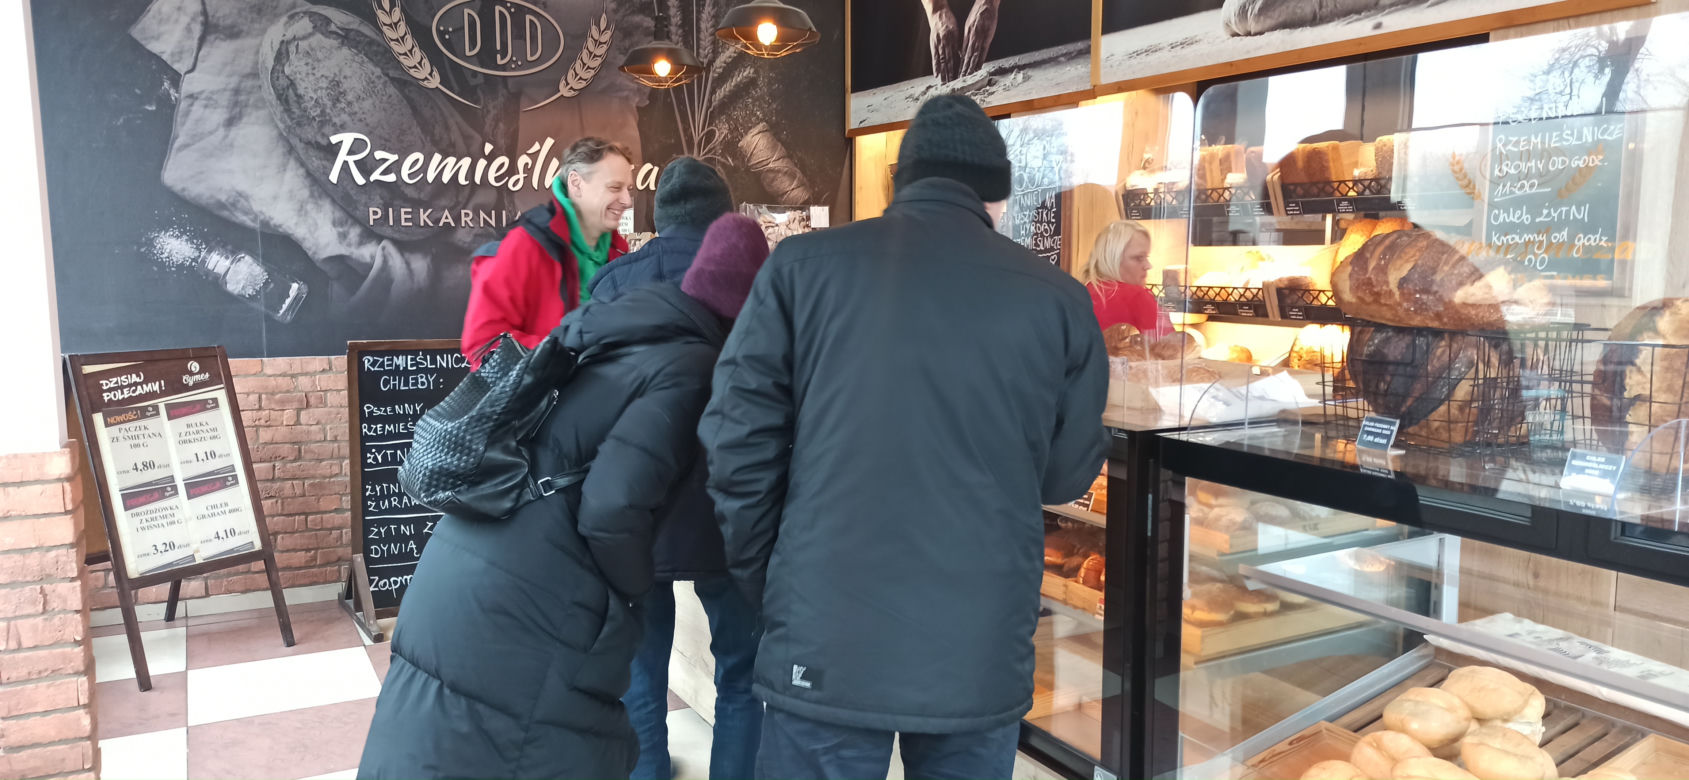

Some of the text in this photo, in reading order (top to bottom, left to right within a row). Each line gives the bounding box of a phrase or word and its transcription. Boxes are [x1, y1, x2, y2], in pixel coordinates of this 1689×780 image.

[1495, 123, 1624, 155] RZEMIEŚLNICZE
[328, 132, 660, 192] Rzemieśla
[1494, 159, 1545, 178] KROIMY
[1548, 156, 1569, 171] OD
[1045, 190, 1056, 210] NA
[1535, 202, 1590, 223] ŻYTNI
[1013, 233, 1062, 250] EMIEŚLNICZE
[1551, 227, 1568, 242] od
[362, 351, 472, 372] RZEMIEŚLNICZ
[99, 371, 145, 390] DZISIAJ
[182, 371, 210, 387] Cymes
[362, 418, 416, 436] RZEMIEŚ
[194, 449, 217, 464] 1,10
[366, 448, 411, 464] ŻYTN
[132, 460, 155, 473] 4,80
[196, 510, 227, 520] GRAHAM
[214, 527, 236, 541] 4,10
[368, 523, 414, 539] ŻYTNI
[152, 540, 176, 555] 3,20
[370, 540, 420, 558] DYNIĄ
